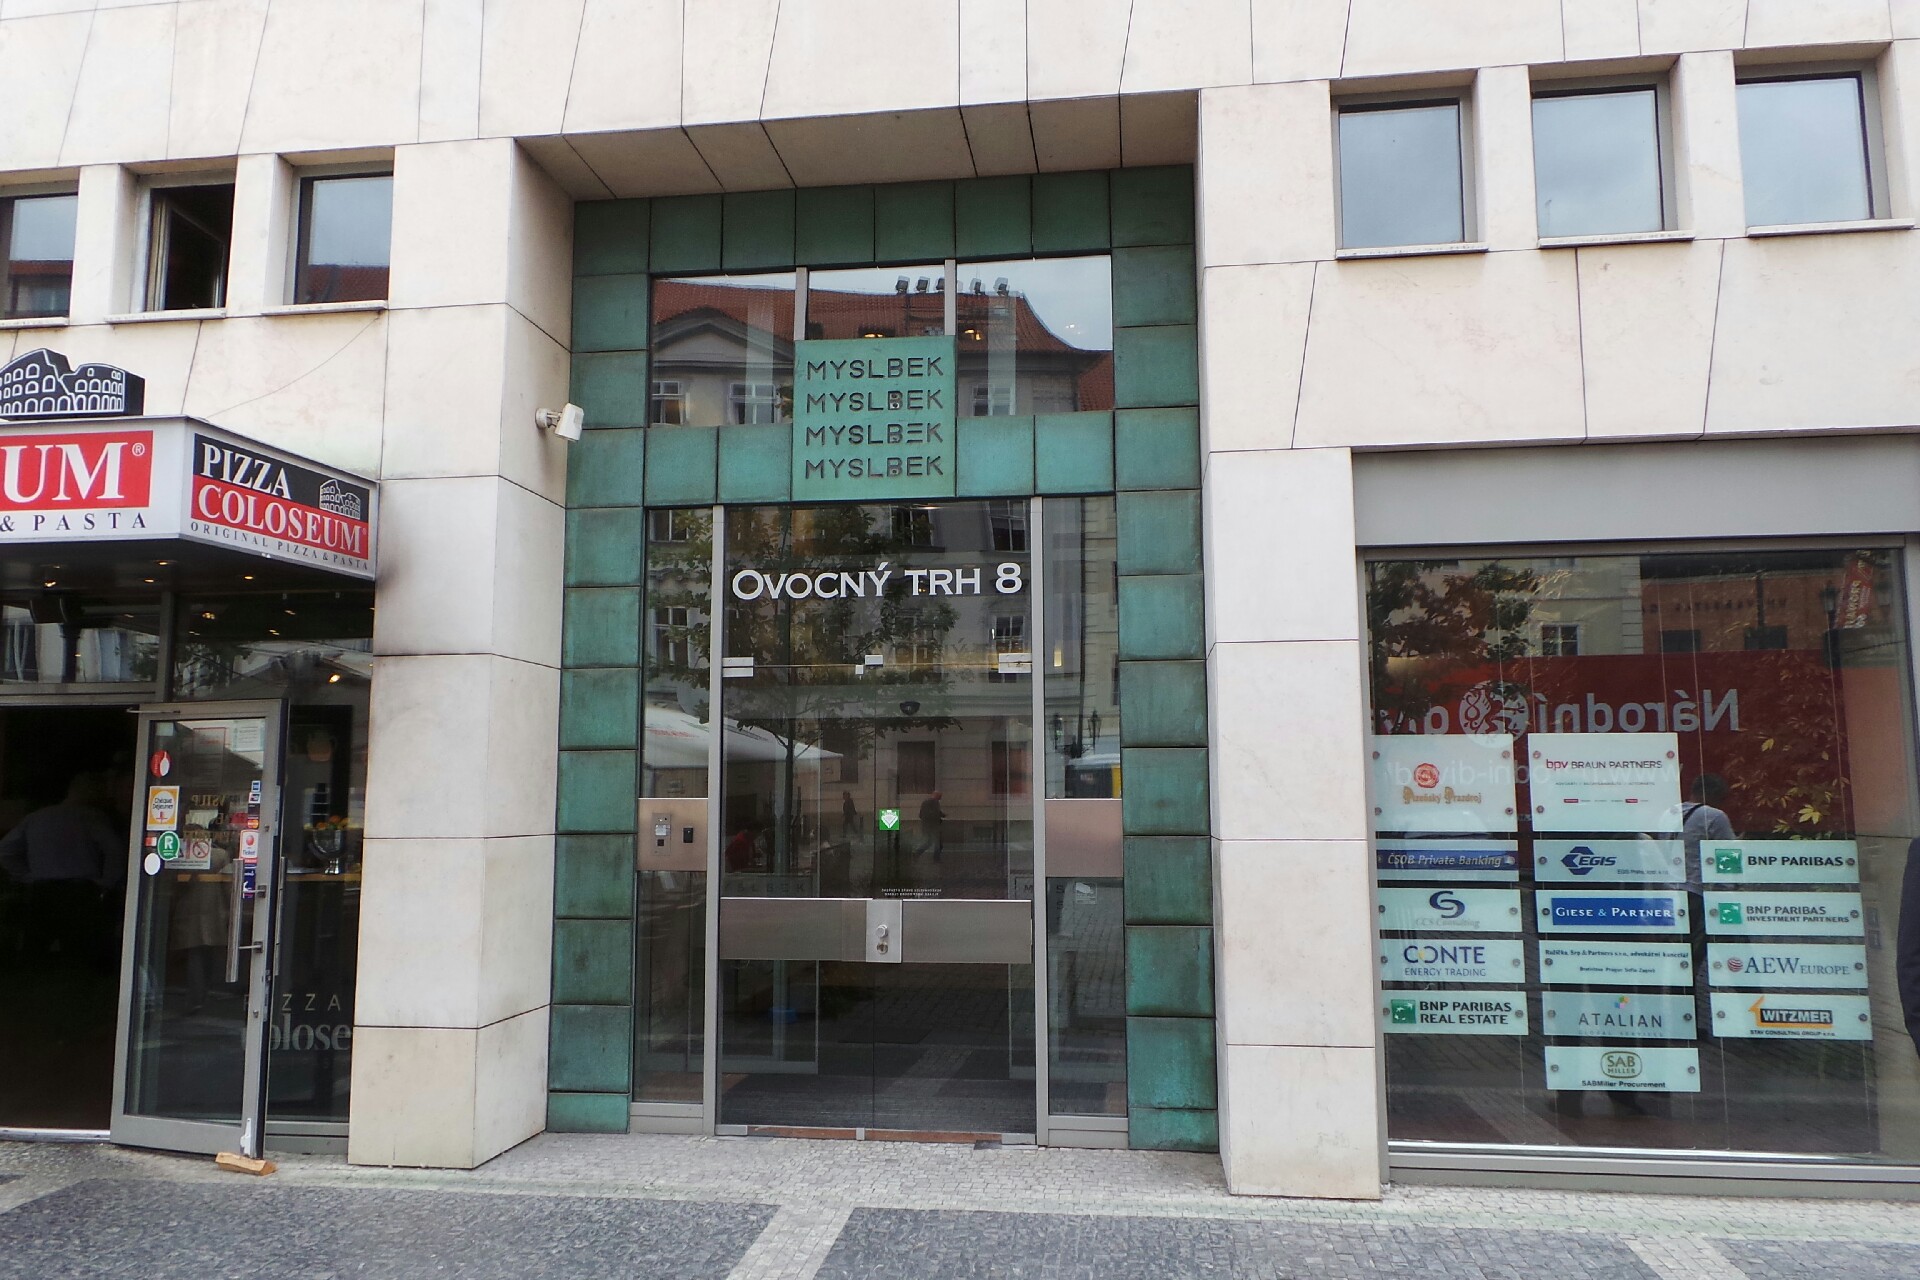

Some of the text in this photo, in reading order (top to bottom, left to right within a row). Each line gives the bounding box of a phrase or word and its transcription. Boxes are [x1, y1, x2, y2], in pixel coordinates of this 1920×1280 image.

[807, 357, 943, 380] MYSLBEK
[807, 389, 943, 413] MYSLBEK
[806, 422, 943, 446] MYSLBEK
[202, 442, 292, 500] PIZZA
[805, 456, 943, 479] MYSLBEK
[33, 513, 146, 531] PASTA
[199, 484, 361, 554] COLOSEUM
[191, 521, 368, 570] ORIGINAL PIZZA & PASTA
[904, 568, 981, 596] TRH
[995, 562, 1022, 594] 8
[1546, 759, 1663, 771] bpv BRAUN PARTNERS
[1418, 855, 1456, 865] Private
[1458, 855, 1501, 868] Banking
[1579, 856, 1617, 866] EGIS
[1747, 856, 1844, 866] BNP PARIBAS
[1555, 907, 1672, 917] GIESE & PARTNER
[1746, 906, 1827, 915] BNP PARIBAS
[1403, 945, 1486, 964] CONTE
[1404, 967, 1487, 977] ENERGY TRADING
[1744, 957, 1850, 975] AEW EUROPE
[1420, 1001, 1512, 1012] BNP PARIBAS
[1420, 1013, 1509, 1024] REAL ESTATE
[1578, 1012, 1663, 1028] ATALIAN
[1762, 1009, 1831, 1023] WITZMER
[1607, 1055, 1636, 1068] SAB
